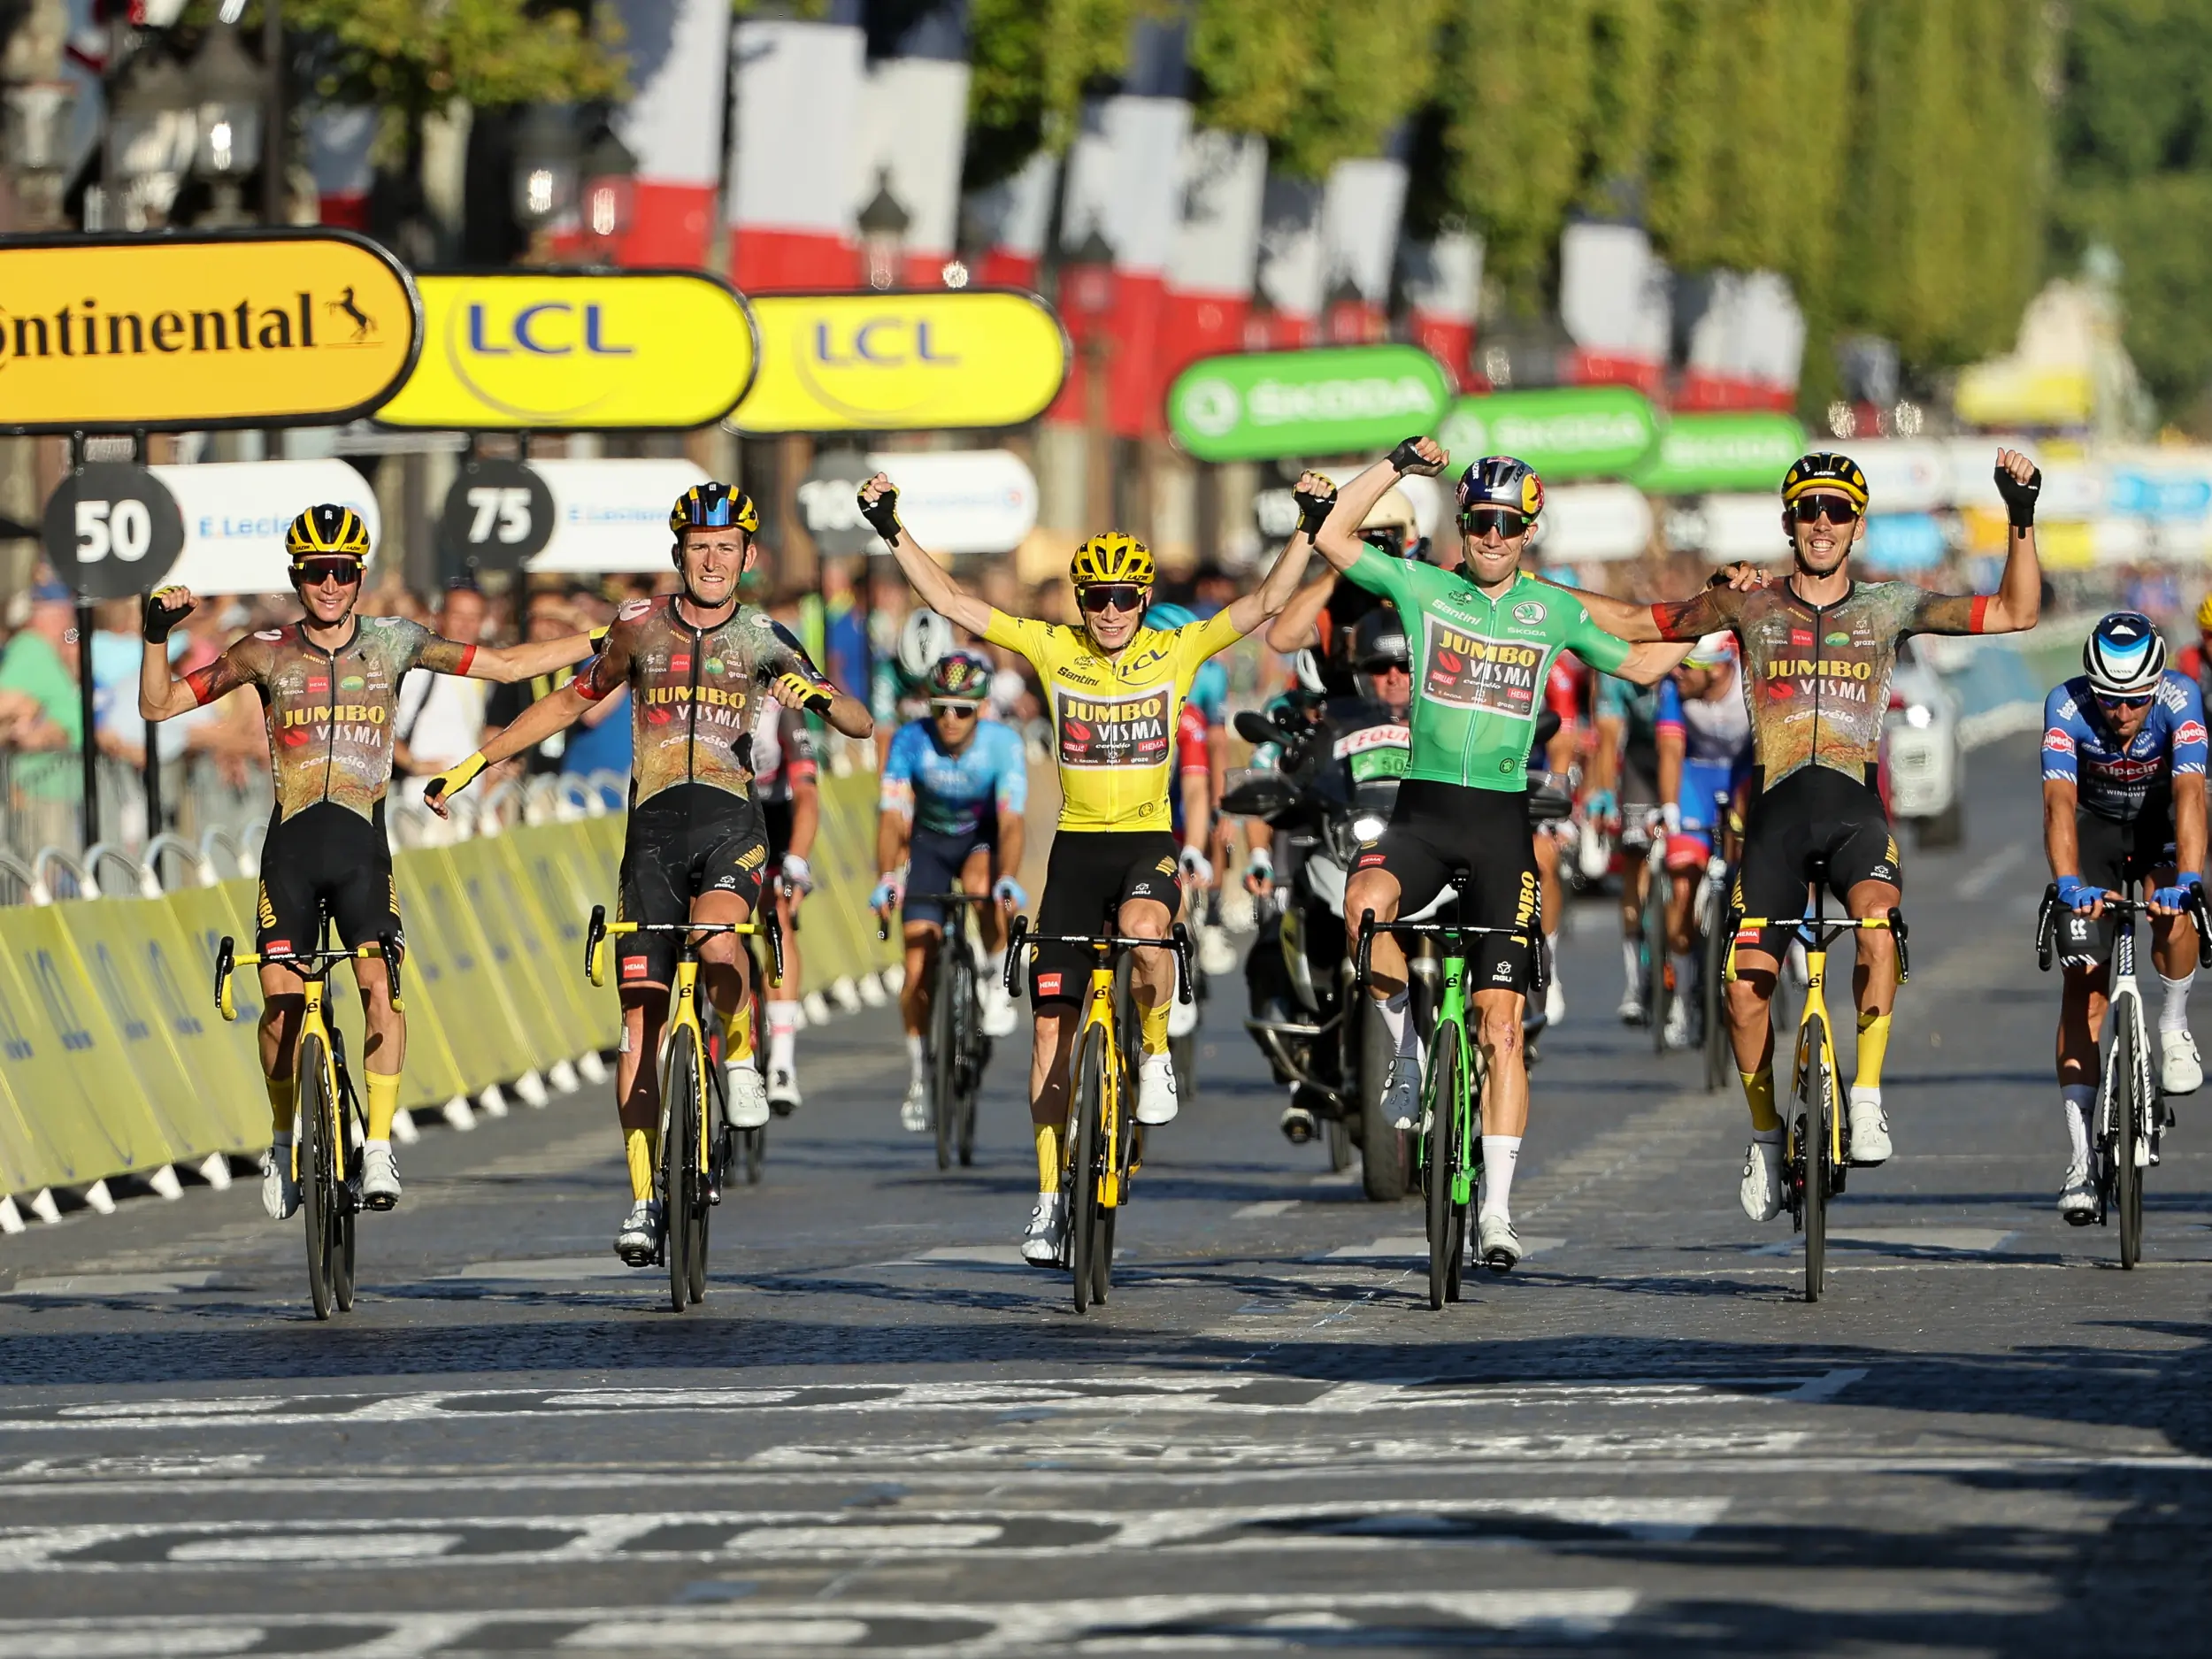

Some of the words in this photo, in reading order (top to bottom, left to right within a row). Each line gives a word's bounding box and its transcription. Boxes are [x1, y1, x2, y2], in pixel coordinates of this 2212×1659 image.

[0, 292, 317, 357] ntinental
[468, 303, 633, 353] LCL
[816, 319, 956, 363] LCL
[467, 487, 531, 542] 75
[75, 499, 150, 562] 50
[1432, 599, 1482, 626] Santini
[1439, 629, 1536, 667] JUMBO
[1122, 649, 1169, 677] LCL
[1470, 659, 1530, 687] VISMA
[1766, 659, 1871, 680] JUMBO
[1057, 666, 1100, 687] Santini
[648, 685, 746, 709] JUMBO
[1510, 690, 1530, 700] HEMA
[1800, 679, 1866, 703] VISMA
[283, 704, 386, 729] JUMBO
[677, 703, 741, 730] VISMA
[1064, 698, 1162, 723] JUMBO
[316, 725, 380, 748] VISMA
[1097, 718, 1163, 741] VISMA
[2044, 733, 2073, 749] Alpecin
[2175, 726, 2206, 741] Alpecin
[1141, 741, 1164, 751] HEMA
[2096, 762, 2158, 776] Alpecin
[2106, 788, 2147, 798] WINDOWS
[733, 842, 766, 872] JUMBO
[1870, 872, 1893, 880] AGU
[258, 879, 278, 929] JUMBO
[1736, 929, 1758, 939] HEMA
[267, 945, 289, 954] HEMA
[625, 962, 645, 971] HEMA
[1039, 979, 1059, 989] HEMA
[1492, 974, 1513, 983] AGU
